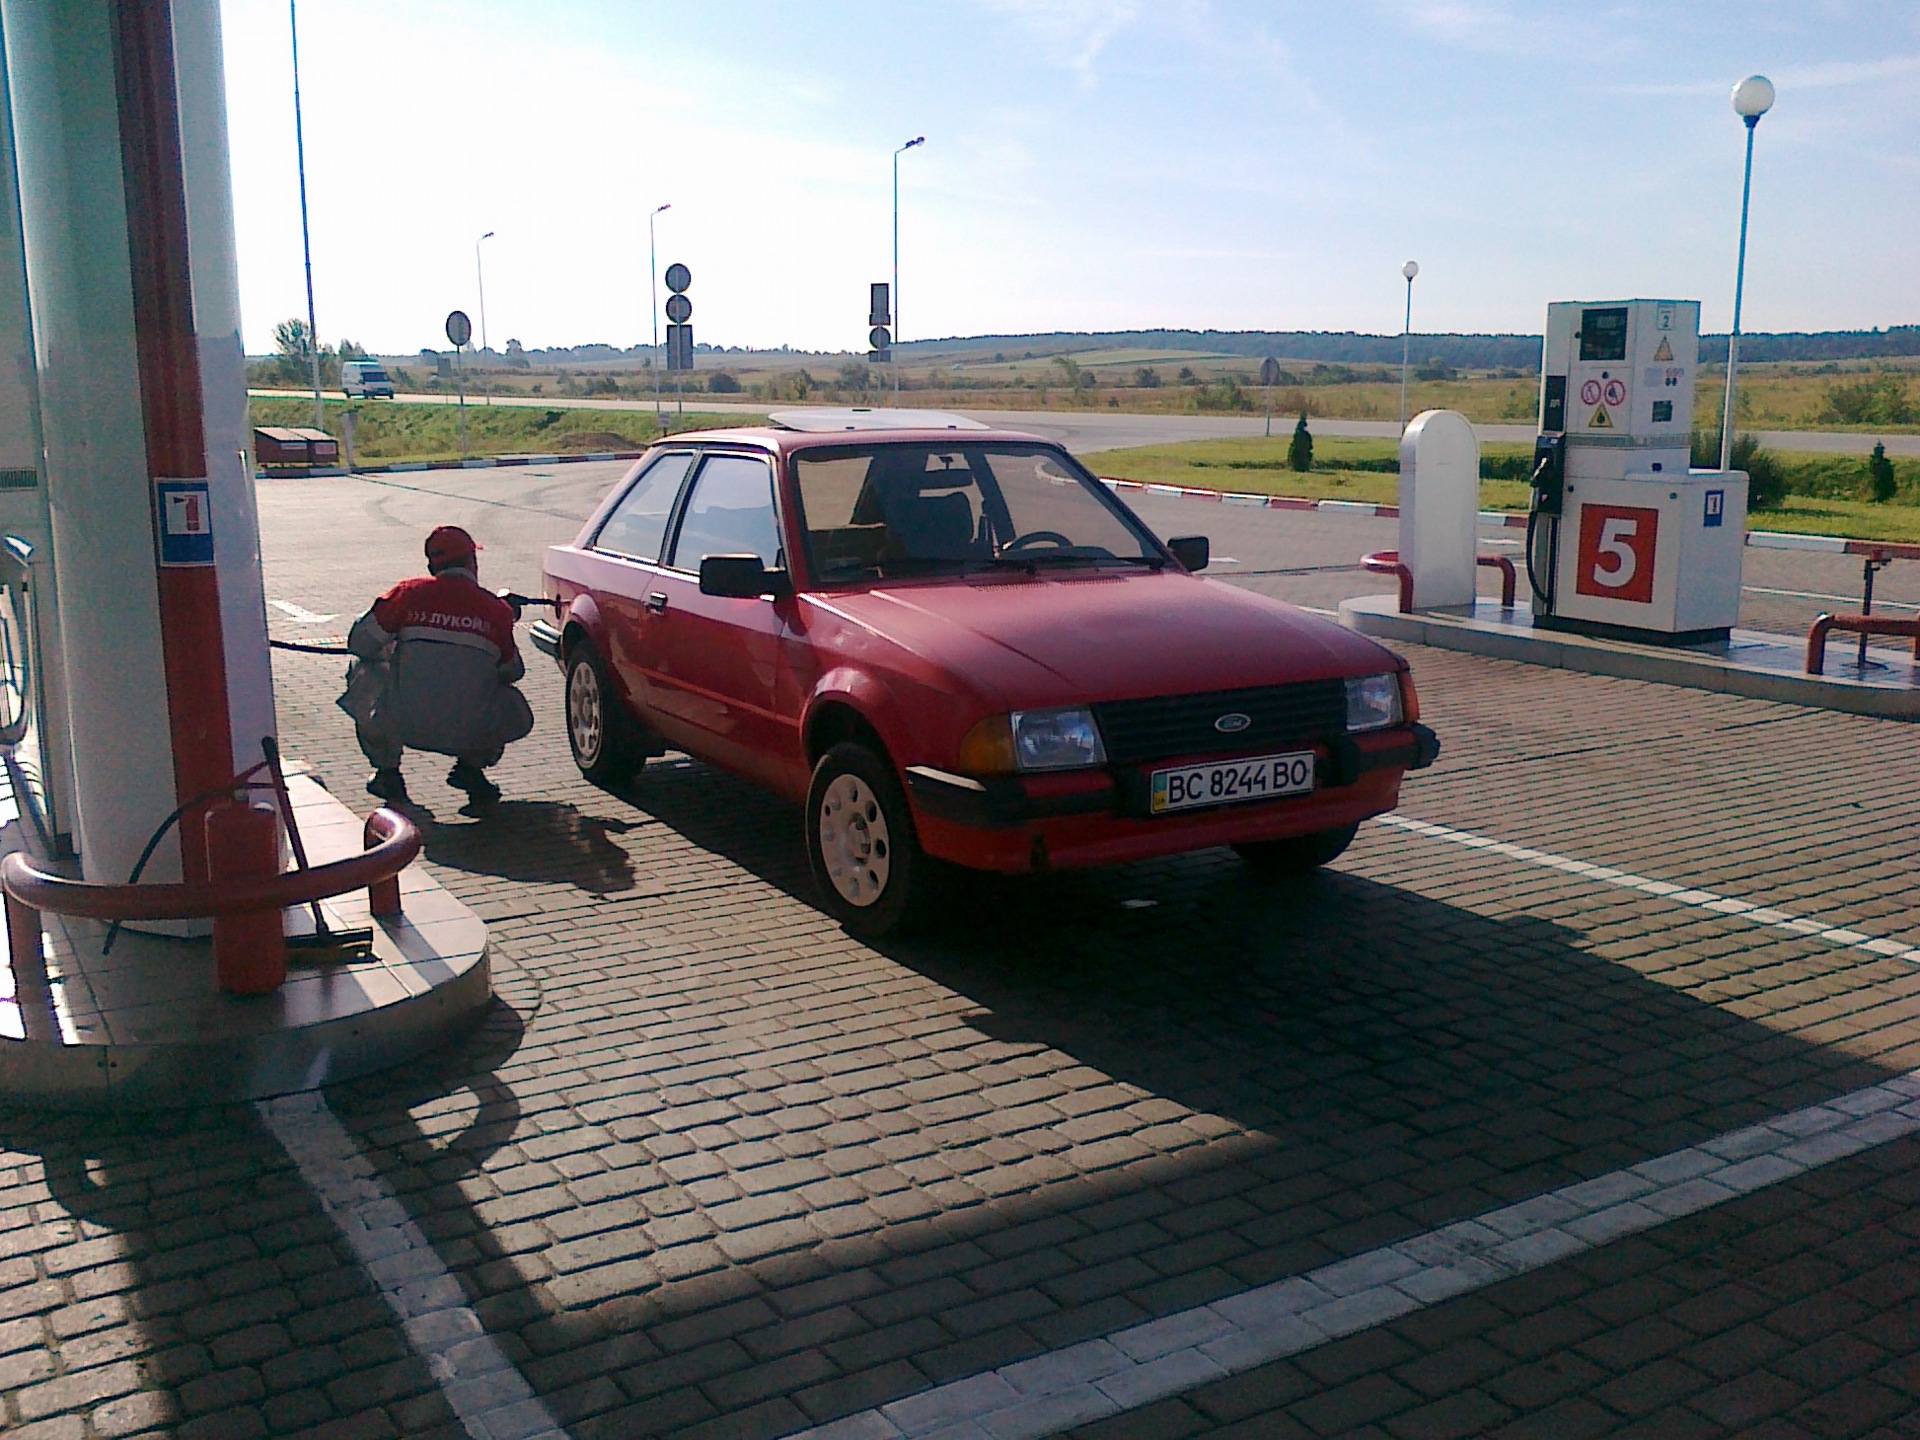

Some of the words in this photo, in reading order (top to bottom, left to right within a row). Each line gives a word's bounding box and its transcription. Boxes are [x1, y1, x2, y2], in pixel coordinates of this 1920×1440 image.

[1593, 517, 1639, 588] 5
[1169, 772, 1203, 803] BC
[1210, 764, 1266, 797] 8244
[1273, 759, 1307, 789] BO
